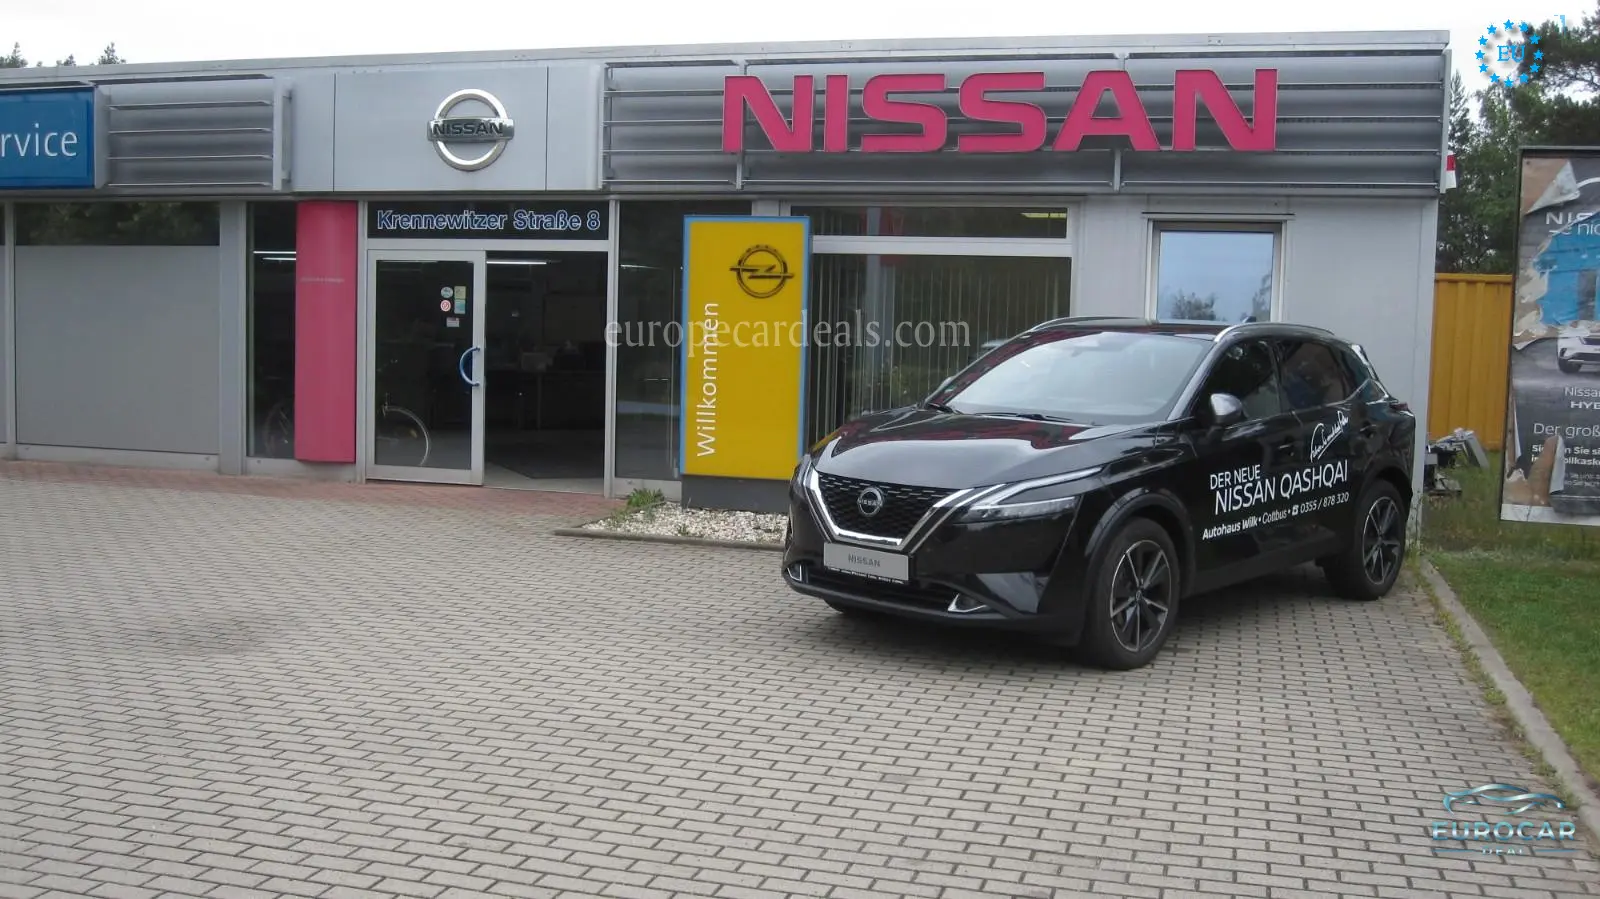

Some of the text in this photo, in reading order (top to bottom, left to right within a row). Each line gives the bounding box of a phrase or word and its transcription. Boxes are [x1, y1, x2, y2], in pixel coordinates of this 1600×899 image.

[721, 68, 1279, 154] NISSAN
[1, 122, 78, 157] rvice
[432, 121, 504, 136] NISSAN
[377, 209, 601, 231] Krennewitzer Straße 8
[696, 302, 719, 458] Willkommen
[1564, 386, 1600, 398] Nissa
[1533, 422, 1560, 436] Der
[1210, 464, 1261, 490] DER NEUE
[1215, 458, 1348, 516] NISSAN QASHQAI
[1202, 522, 1241, 541] Autohaus
[1242, 515, 1259, 530] Wilk
[1262, 508, 1288, 525] Cottbus
[1300, 499, 1318, 514] 0355
[1323, 494, 1336, 508] 878
[1336, 491, 1350, 505] 320
[848, 553, 881, 567] NISSAN
